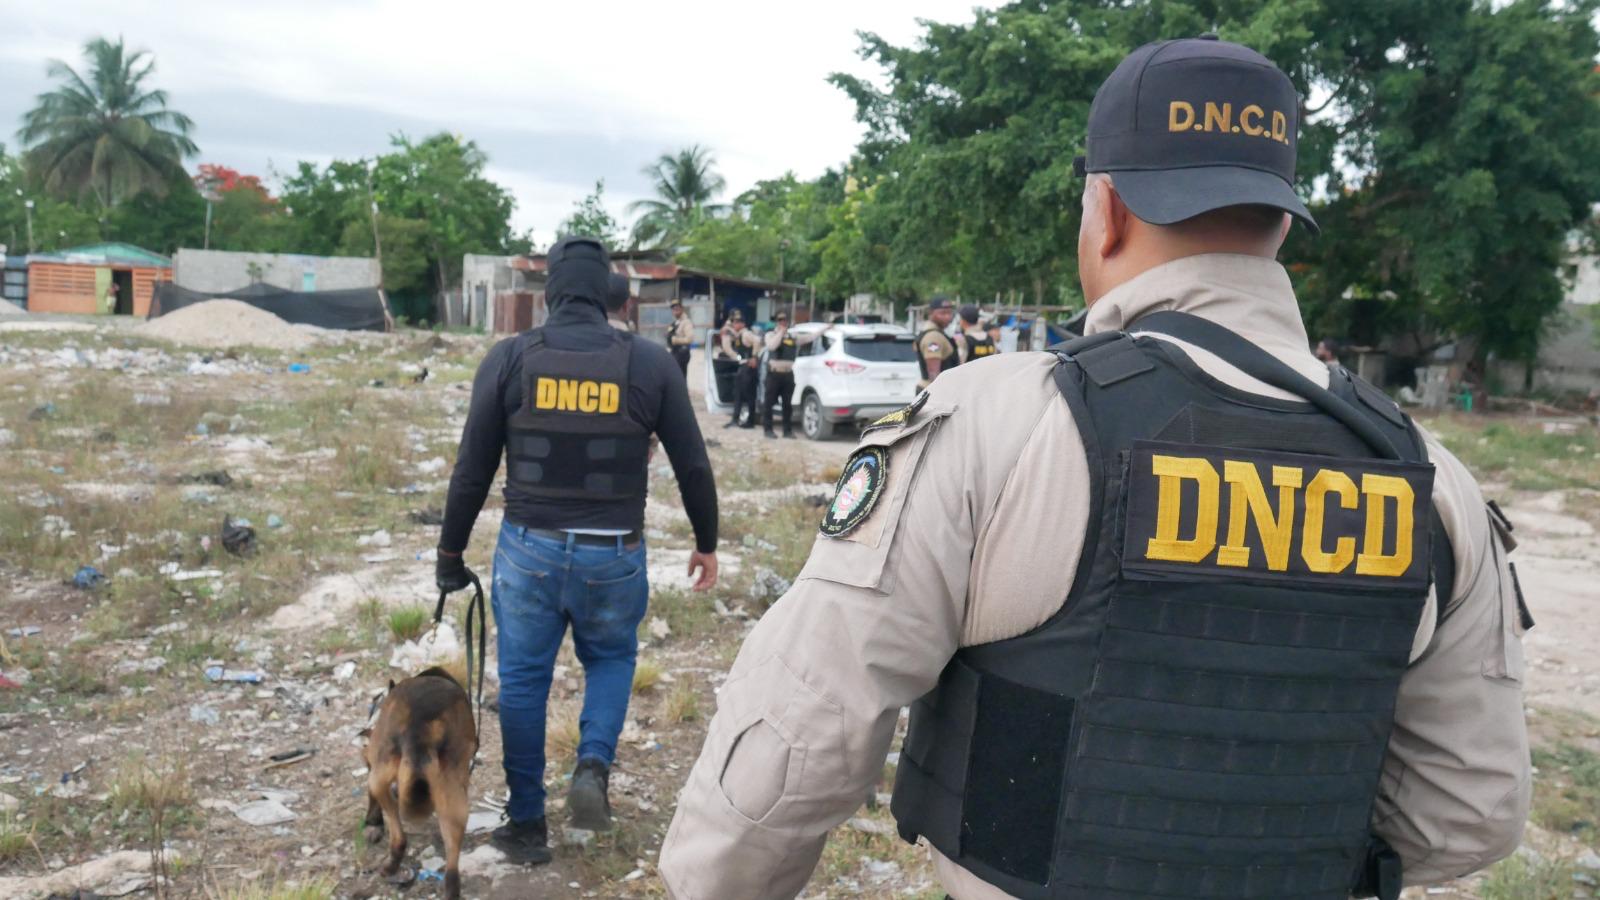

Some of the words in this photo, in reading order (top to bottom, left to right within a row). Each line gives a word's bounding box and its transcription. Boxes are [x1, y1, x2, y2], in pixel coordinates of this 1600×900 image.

[1168, 101, 1289, 145] D.N.C.D.
[535, 377, 620, 414] DNCD
[1146, 456, 1415, 576] DNCD
